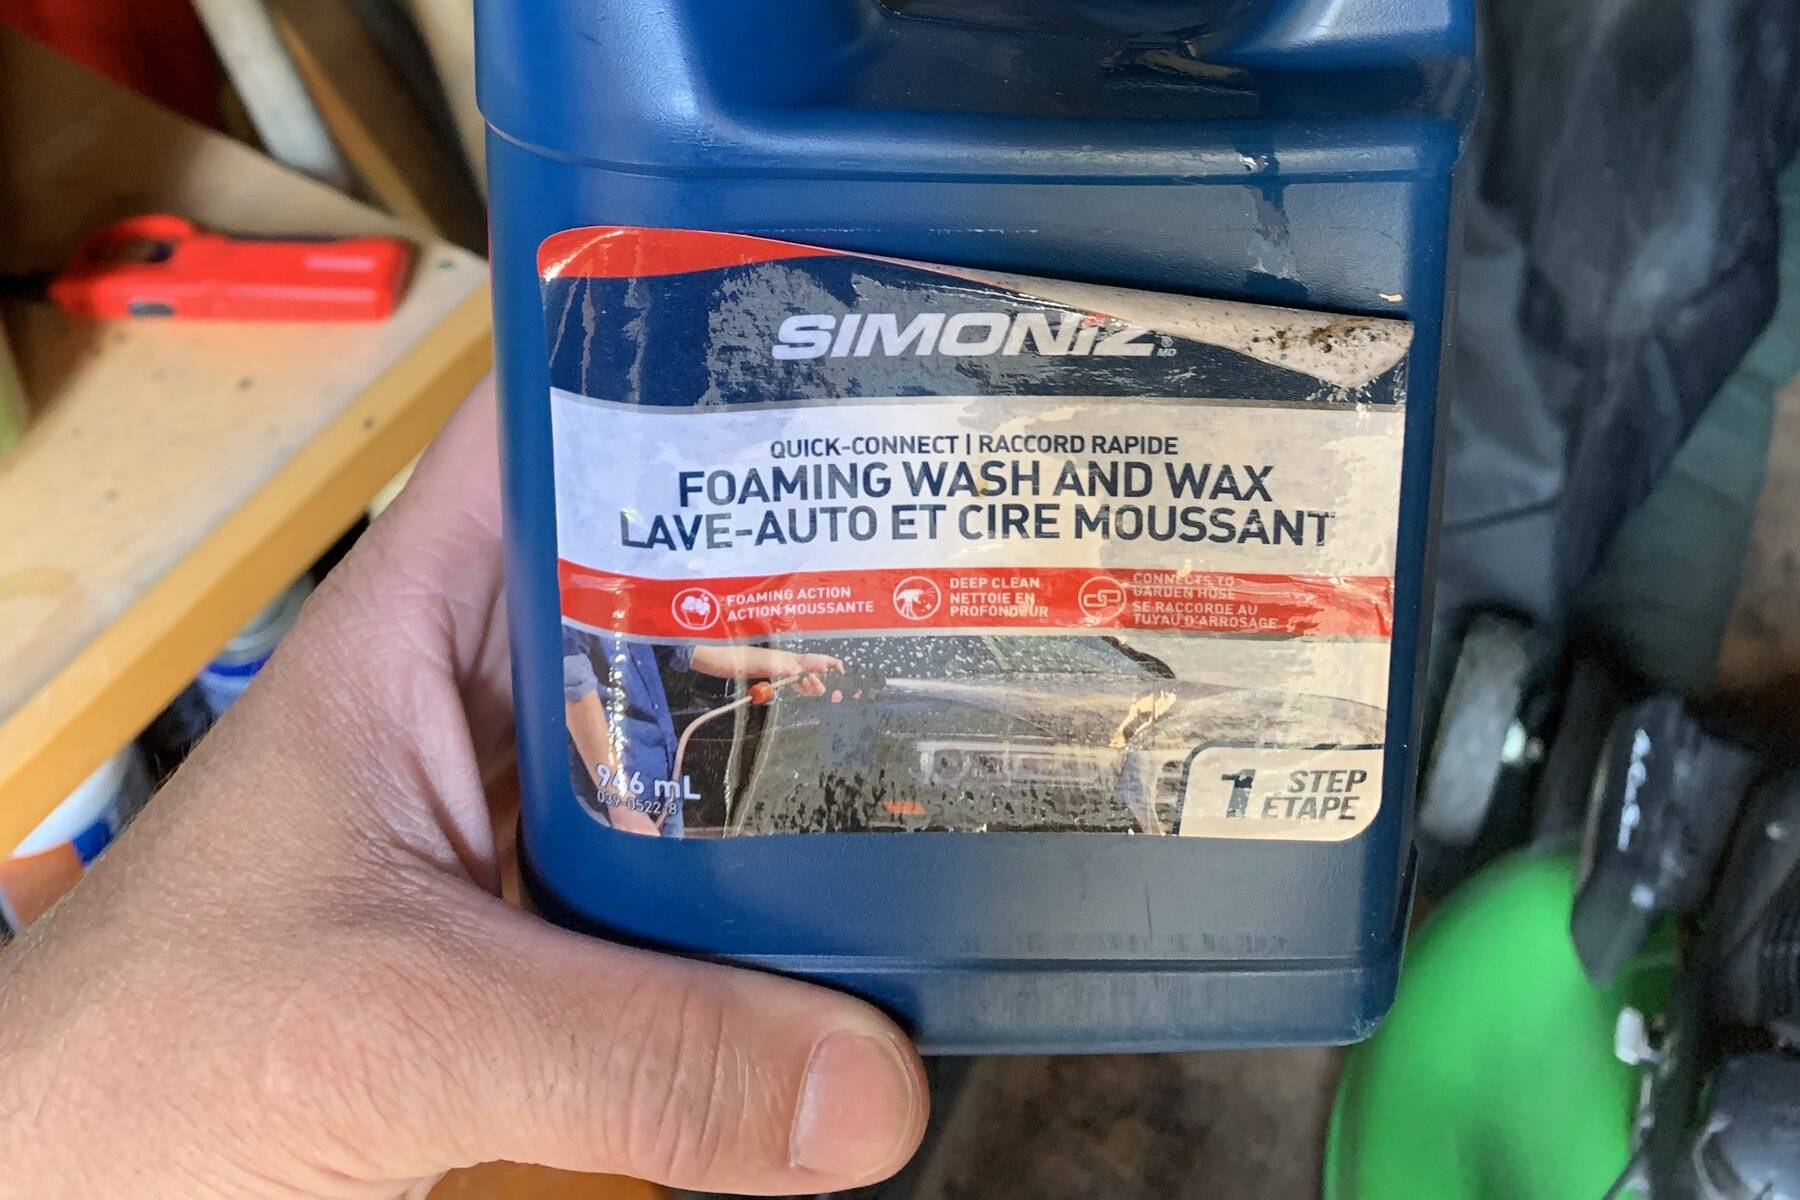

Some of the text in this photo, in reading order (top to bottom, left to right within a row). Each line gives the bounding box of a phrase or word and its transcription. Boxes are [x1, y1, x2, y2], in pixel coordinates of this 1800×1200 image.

[770, 435, 1178, 459] QUICK-CONNECT RACCORD RAPIDE
[678, 460, 1274, 508] FOAMING WASH AND WAX
[620, 503, 1336, 551] LAVE-AUTO ET CIRE MOUSSANT
[950, 577, 1040, 589] DEEP CLEAN
[1133, 572, 1236, 587] CONNECTS TO
[727, 586, 851, 608] FOAMING ACTION
[950, 592, 1035, 605] NETTOIE EN
[1133, 586, 1237, 600] GARDEN HOSE
[727, 600, 874, 623] ACTION MOUSSANTE
[950, 605, 1049, 618] PROFONDEUR
[1132, 601, 1258, 616] SE RACCORDE AU
[1133, 614, 1280, 629] TUYAU D'ARROSAGE
[654, 775, 701, 800] mL
[1287, 770, 1367, 793] STEP
[1221, 769, 1256, 818] 1
